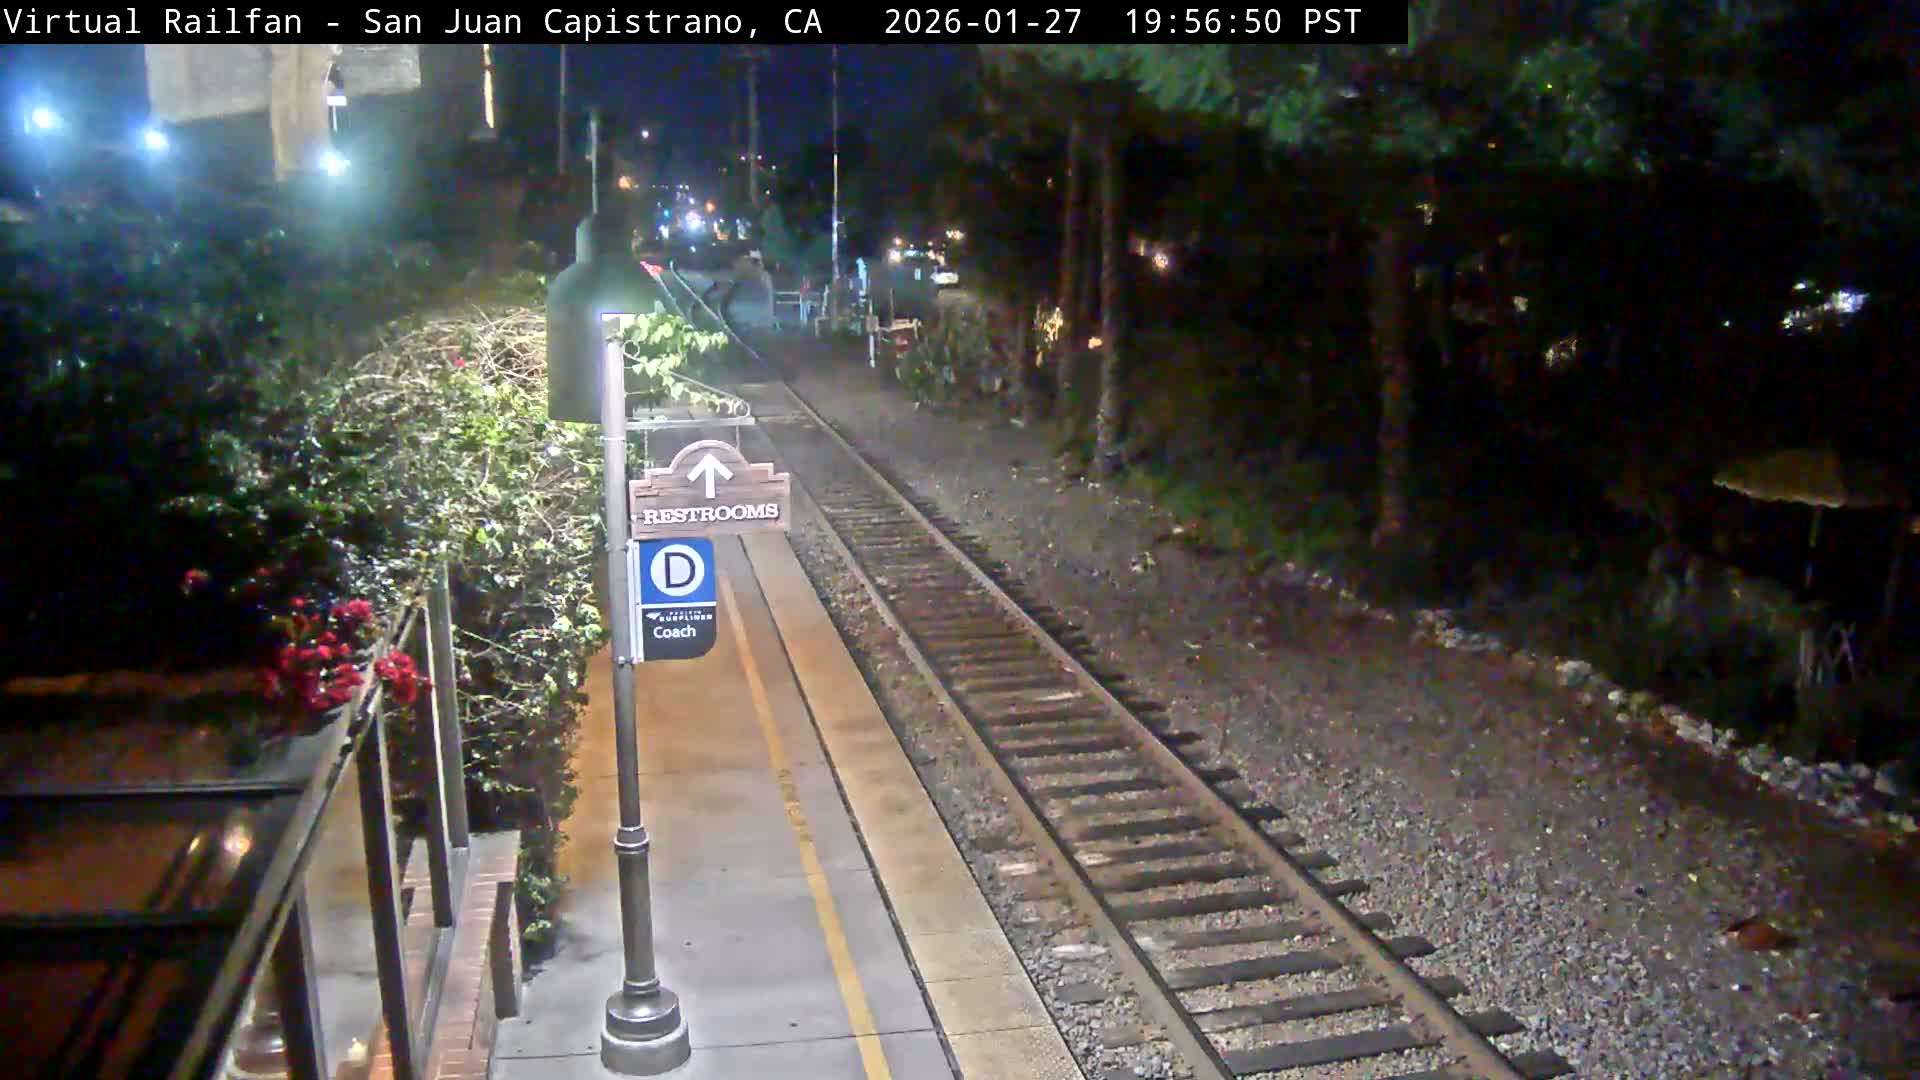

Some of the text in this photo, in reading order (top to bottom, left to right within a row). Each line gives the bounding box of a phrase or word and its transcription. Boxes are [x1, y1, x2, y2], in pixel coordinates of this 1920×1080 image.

[643, 503, 779, 526] RESTROOMS
[664, 551, 696, 589] D
[653, 624, 697, 639] Coach
